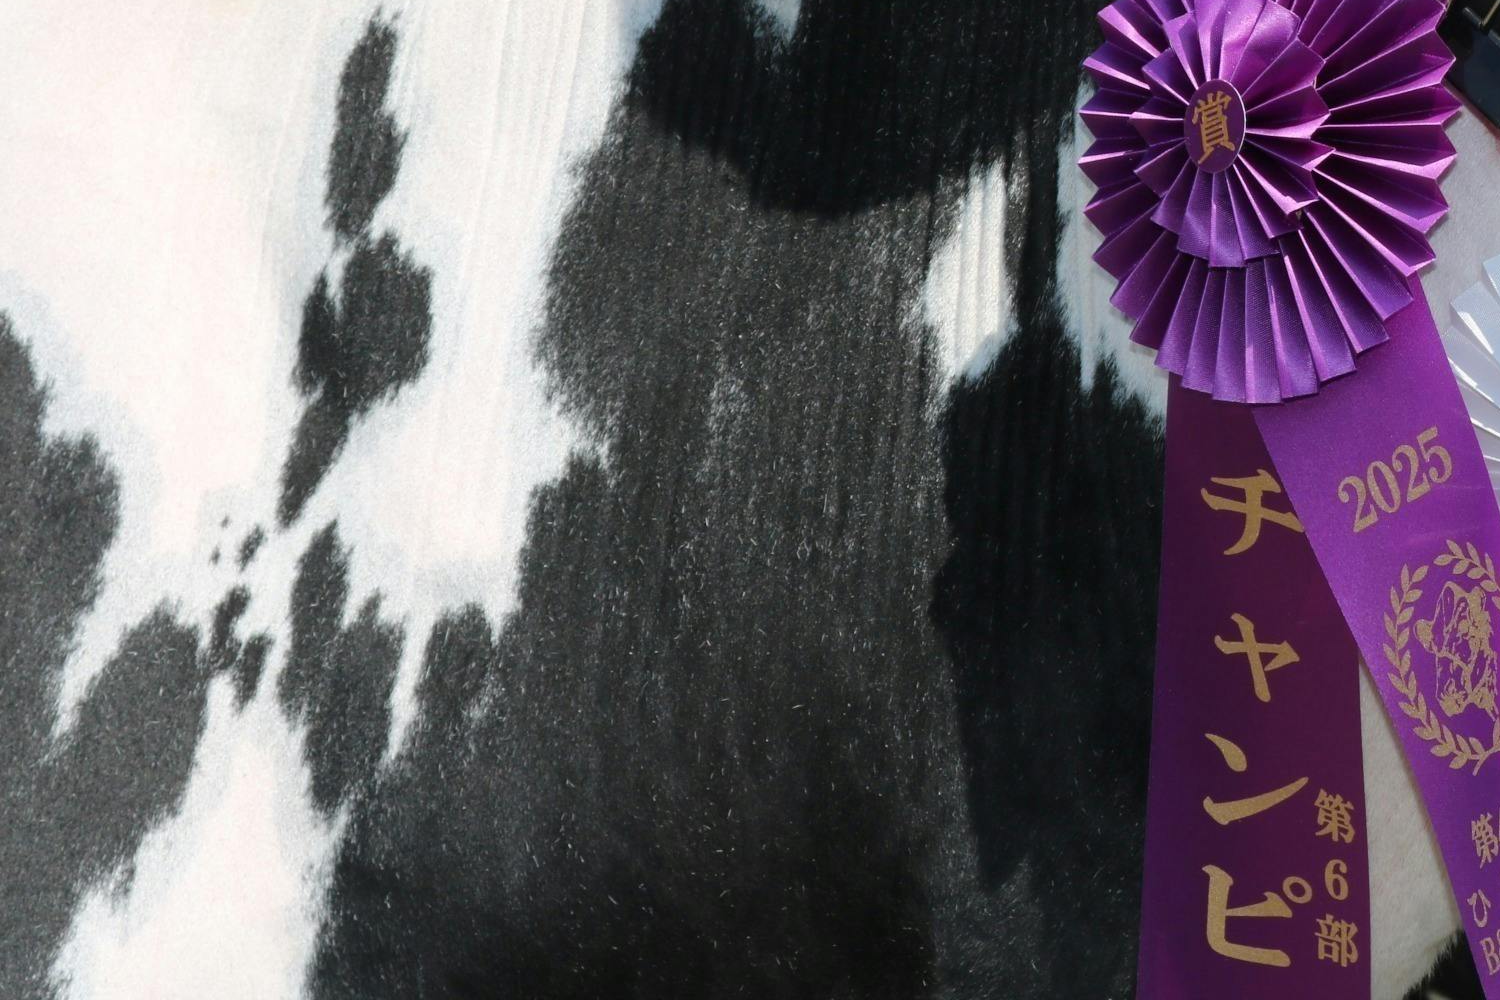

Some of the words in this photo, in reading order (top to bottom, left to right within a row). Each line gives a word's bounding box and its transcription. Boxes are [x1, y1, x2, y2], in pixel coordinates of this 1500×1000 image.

[1192, 90, 1235, 164] 賞
[1338, 426, 1453, 532] 2025
[1200, 468, 1313, 968] チャンピ
[1313, 788, 1359, 968] 第6部
